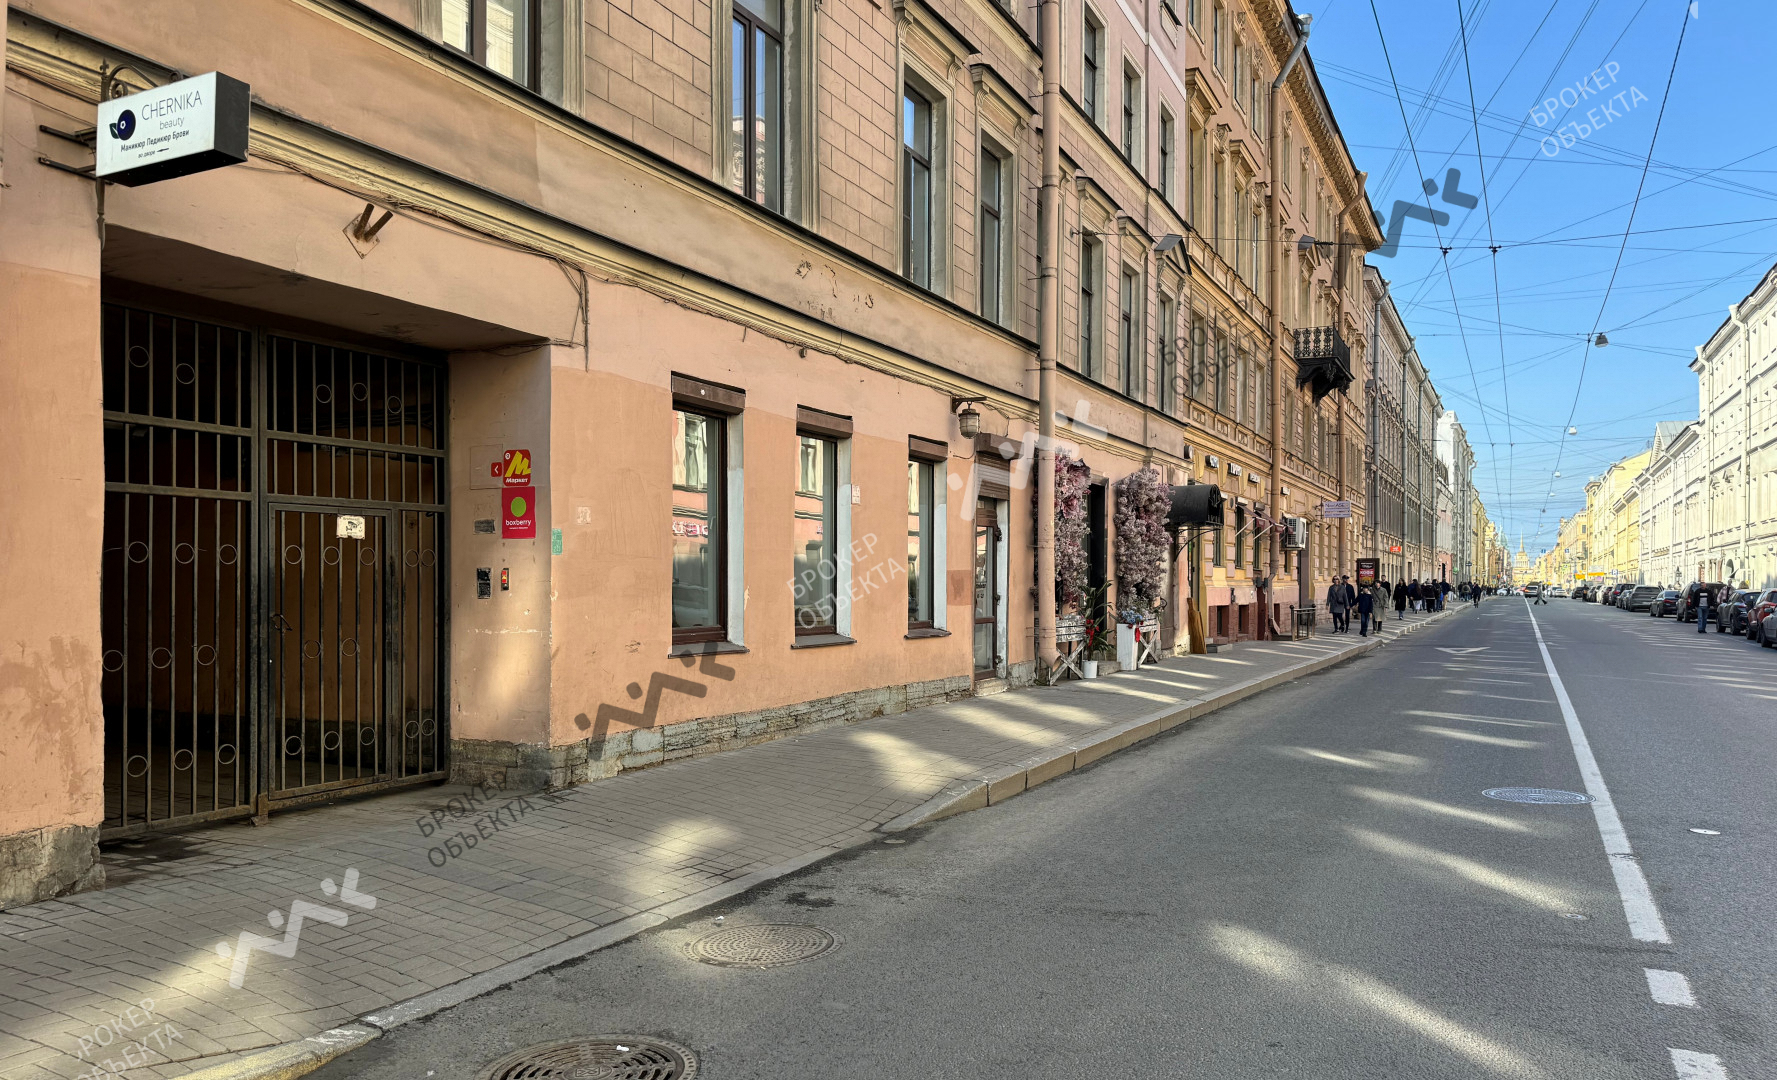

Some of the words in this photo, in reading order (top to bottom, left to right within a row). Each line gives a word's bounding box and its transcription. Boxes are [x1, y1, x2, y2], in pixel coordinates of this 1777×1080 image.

[141, 90, 203, 121] CHERNIKA
[159, 116, 185, 130] beauty
[120, 139, 146, 152] Маникюр
[146, 134, 172, 147] Педикюр
[172, 129, 190, 140] Брови
[147, 150, 156, 158] дворе
[505, 519, 532, 527] boxberry
